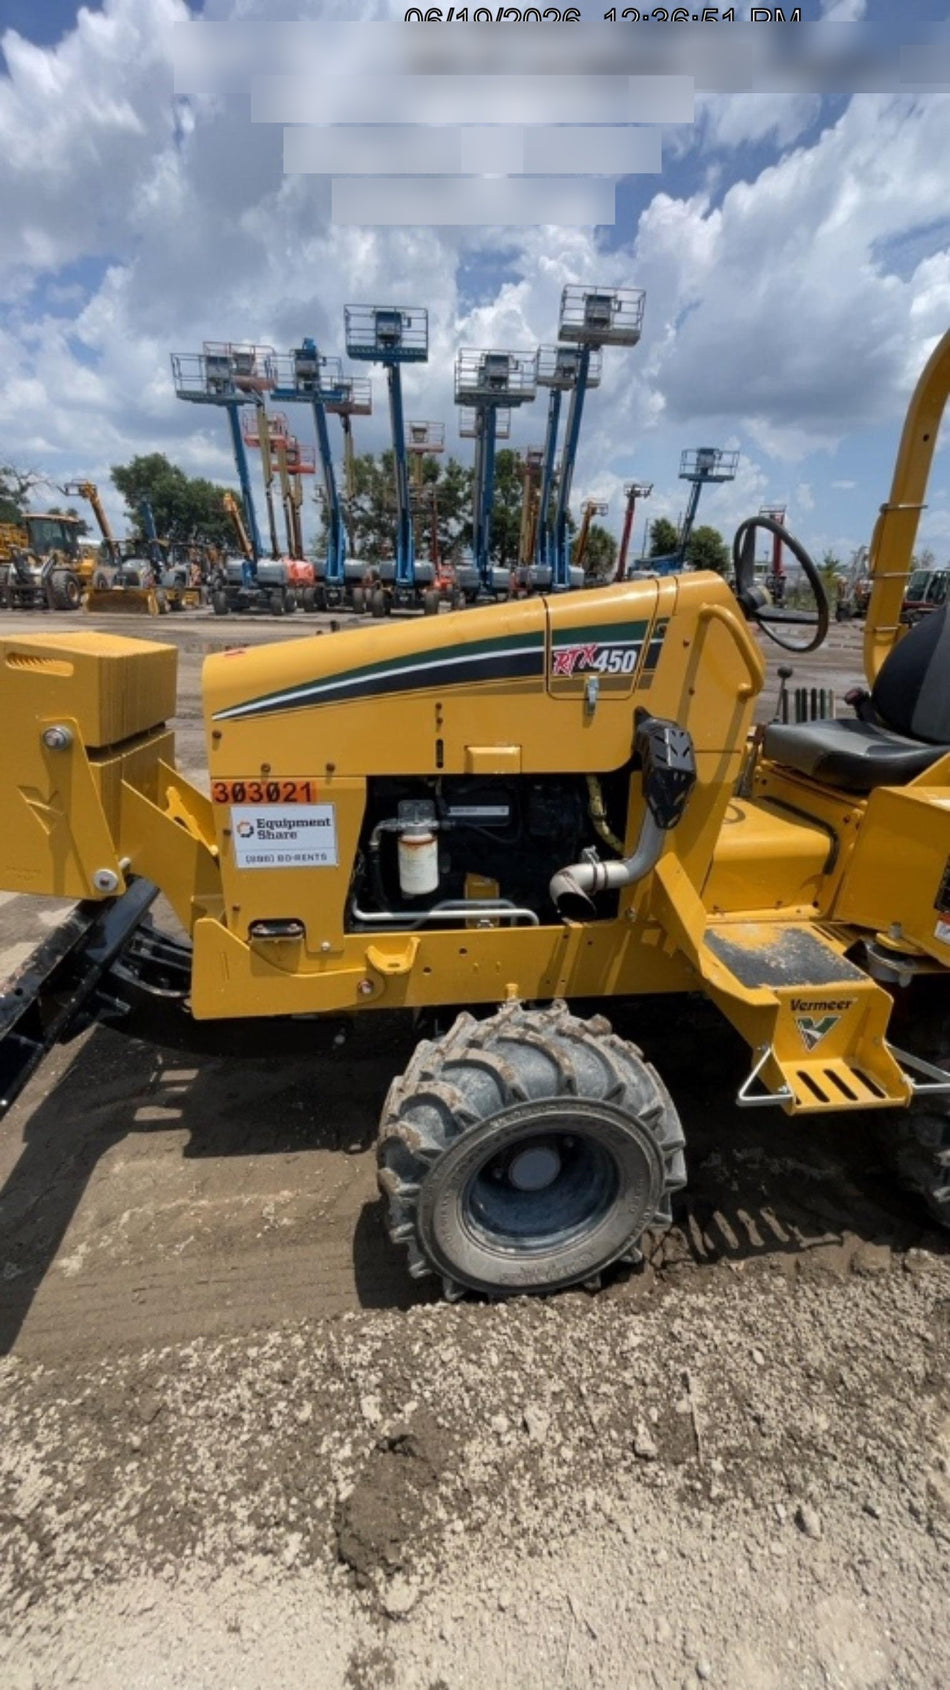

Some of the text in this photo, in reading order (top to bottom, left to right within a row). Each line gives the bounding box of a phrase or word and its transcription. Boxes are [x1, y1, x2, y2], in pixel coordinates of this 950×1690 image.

[214, 782, 311, 803] 303021
[256, 818, 331, 830] Equipment
[257, 830, 297, 840] Share
[791, 998, 852, 1011] Vermeer
